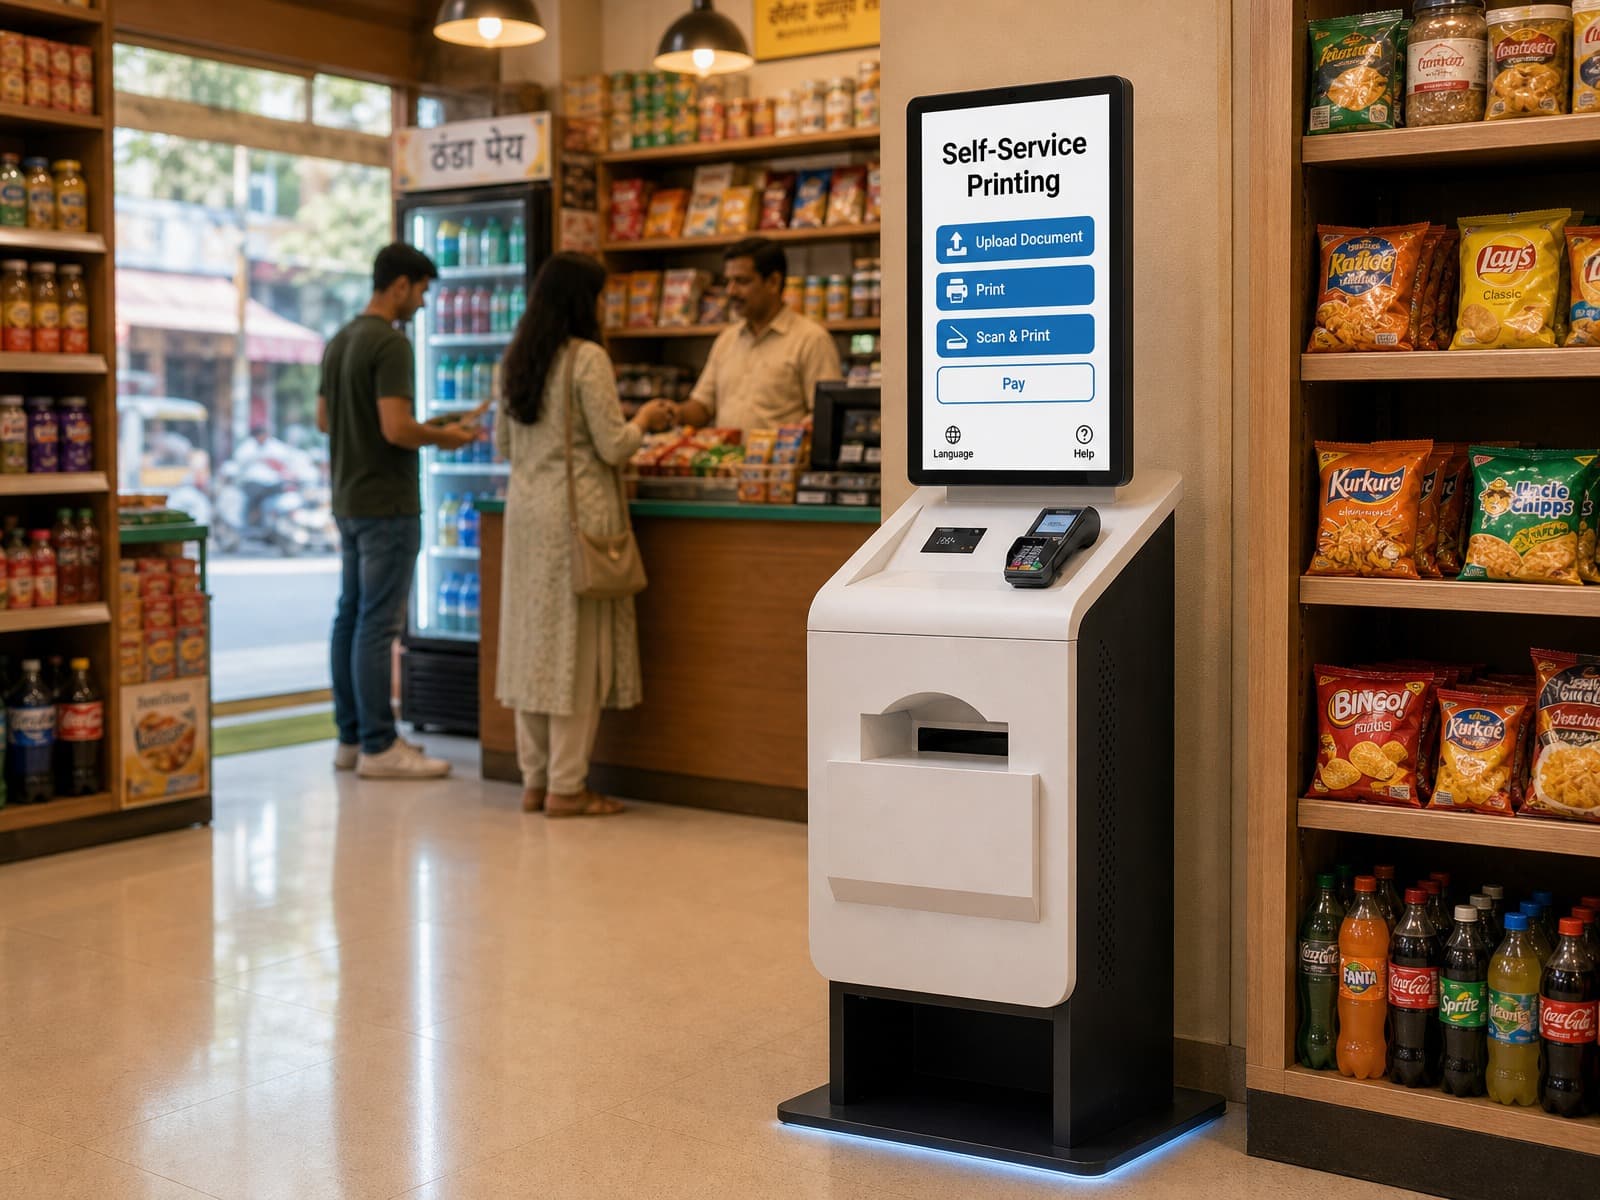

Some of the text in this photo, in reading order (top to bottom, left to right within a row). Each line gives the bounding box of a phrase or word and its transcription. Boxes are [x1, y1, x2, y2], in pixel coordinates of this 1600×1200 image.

[430, 126, 525, 171] ठंडा पेय
[942, 131, 1087, 166] Self-Service
[967, 169, 1060, 199] Printing
[976, 230, 1084, 251] Upload Document
[976, 282, 1005, 297] Print
[1483, 288, 1522, 301] Classic
[976, 327, 1051, 344] Scan & Print
[1002, 376, 1026, 393] Pay
[933, 448, 974, 461] Language
[1073, 448, 1095, 461] Help
[1329, 468, 1401, 500] Kurkure
[1515, 480, 1569, 499] Uncle
[1510, 498, 1574, 519] Chipps
[1343, 968, 1377, 985] FANTA
[1441, 994, 1479, 1016] Sprite
